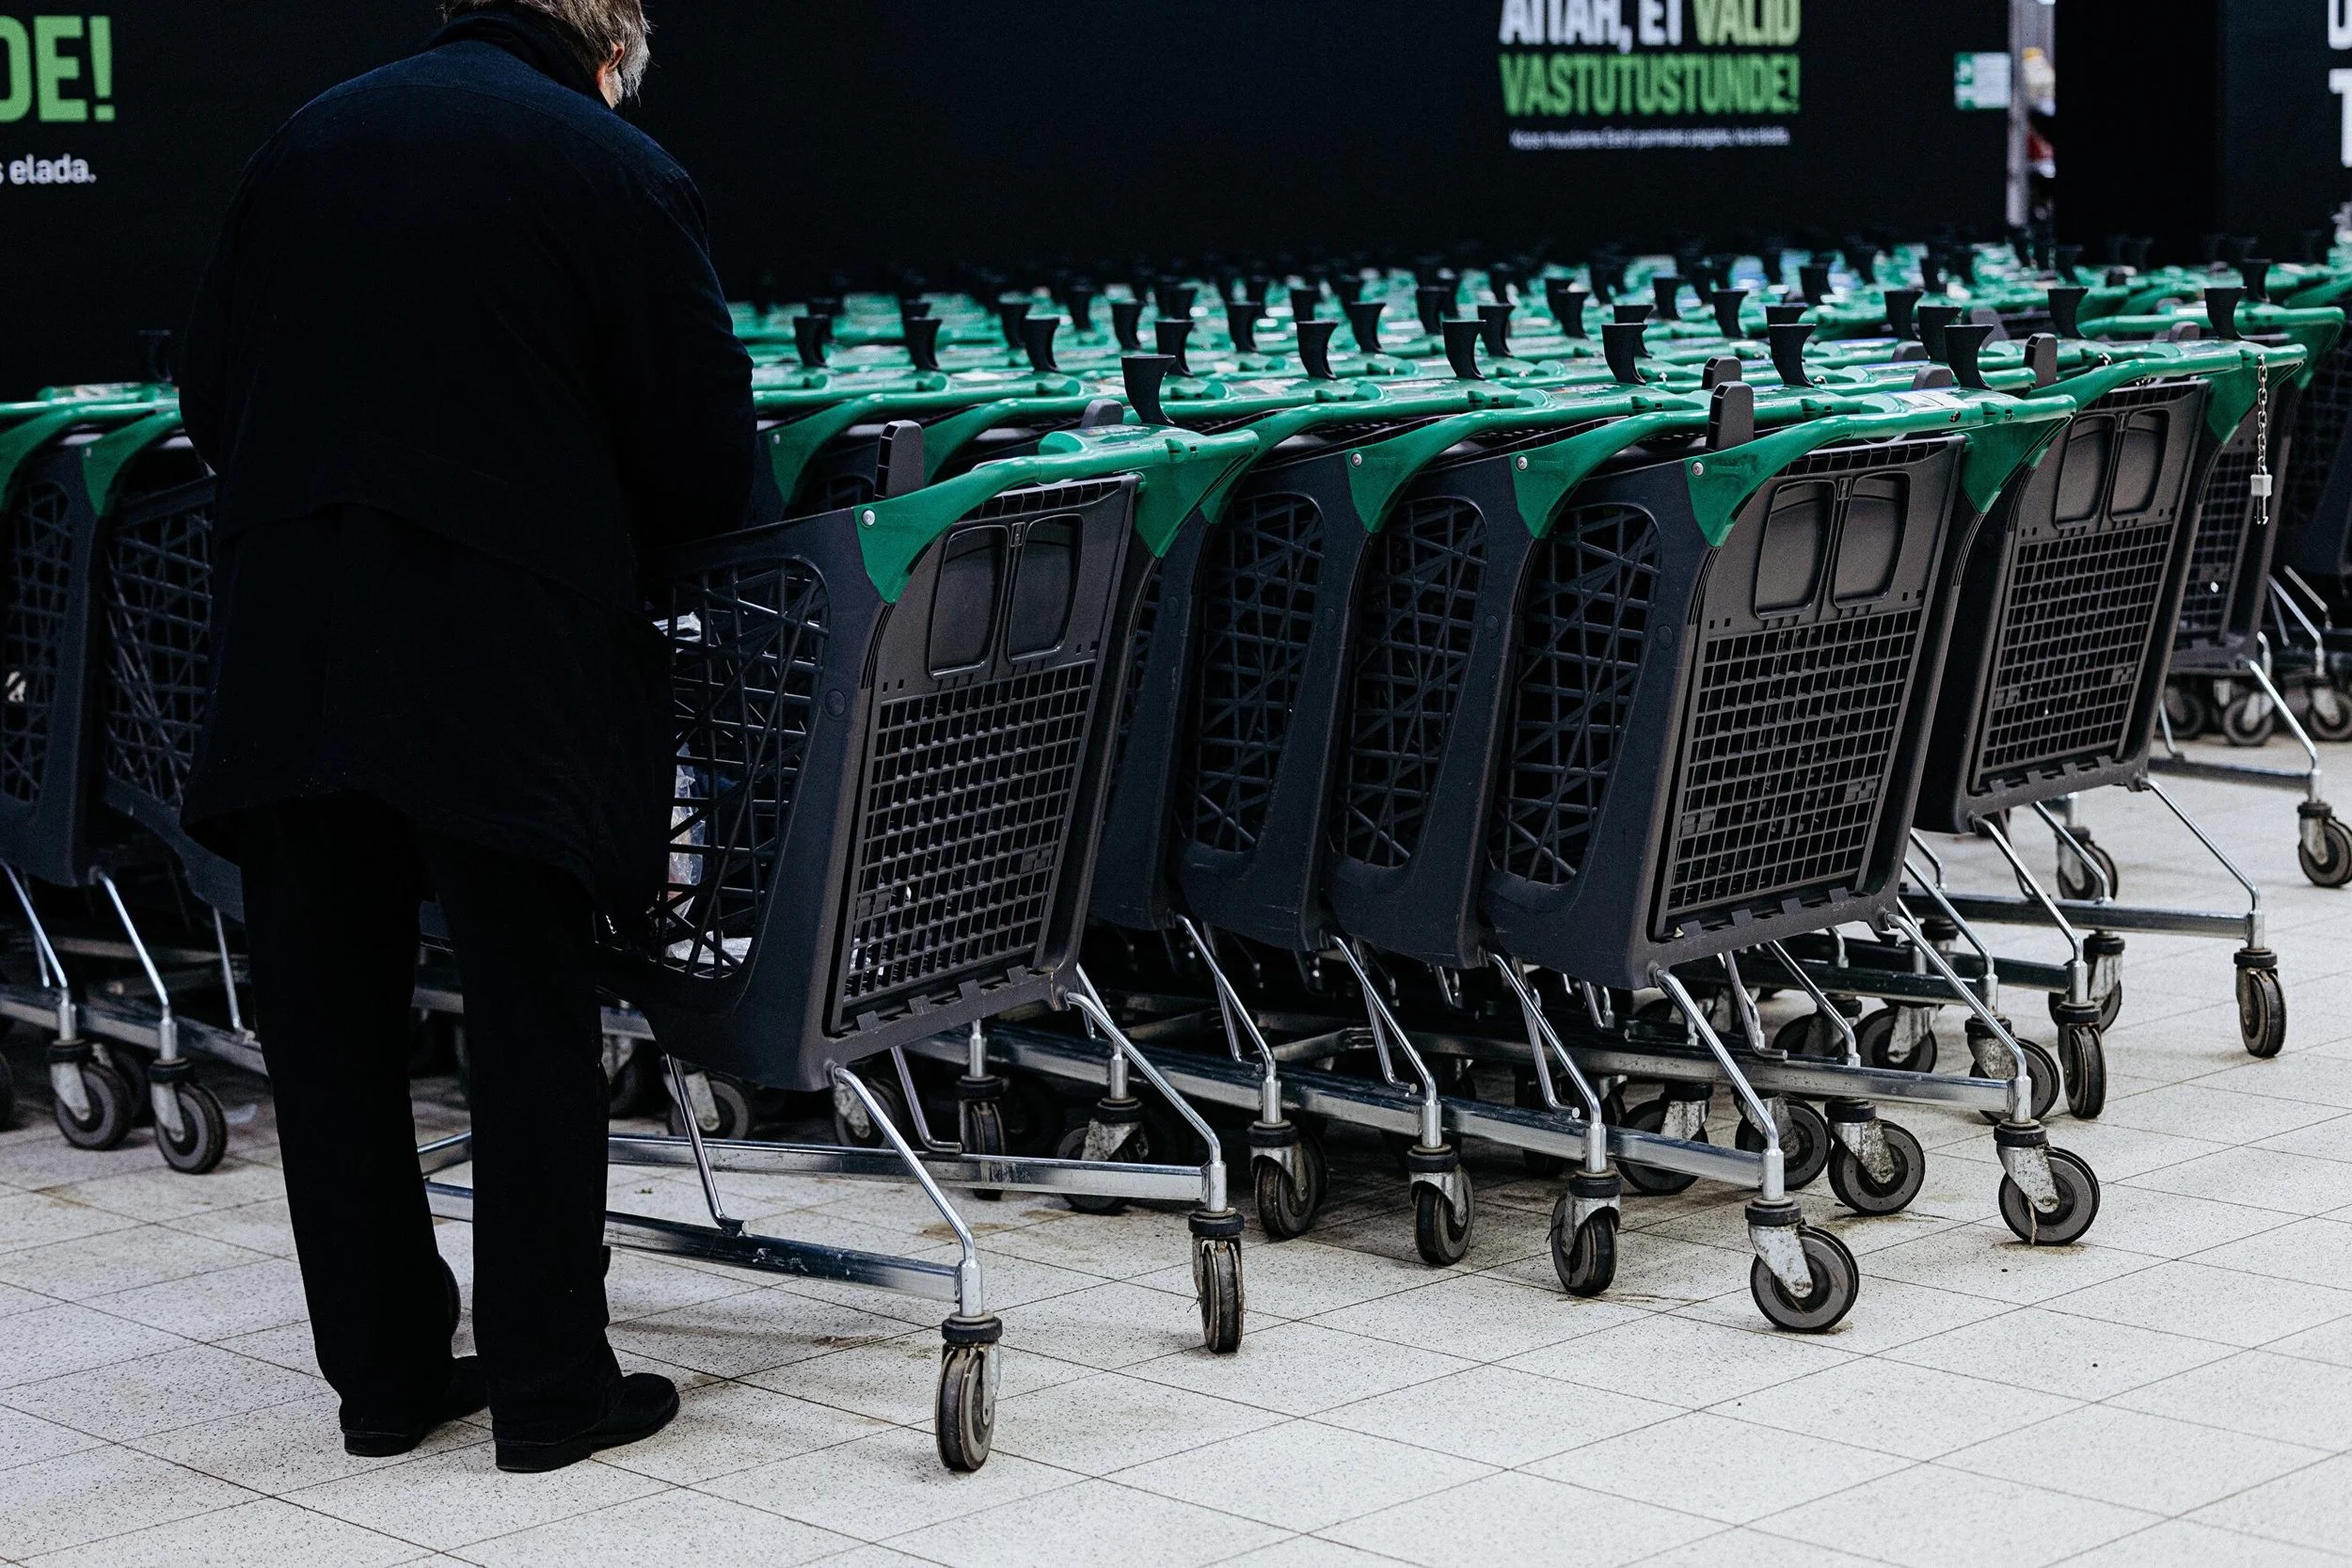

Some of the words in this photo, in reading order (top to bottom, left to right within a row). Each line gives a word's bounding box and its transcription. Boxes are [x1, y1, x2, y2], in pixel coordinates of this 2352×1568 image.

[1638, 0, 1682, 45] EI
[1499, 53, 1801, 117] VASTUTUSTUNDE!
[8, 152, 97, 185] elada.
